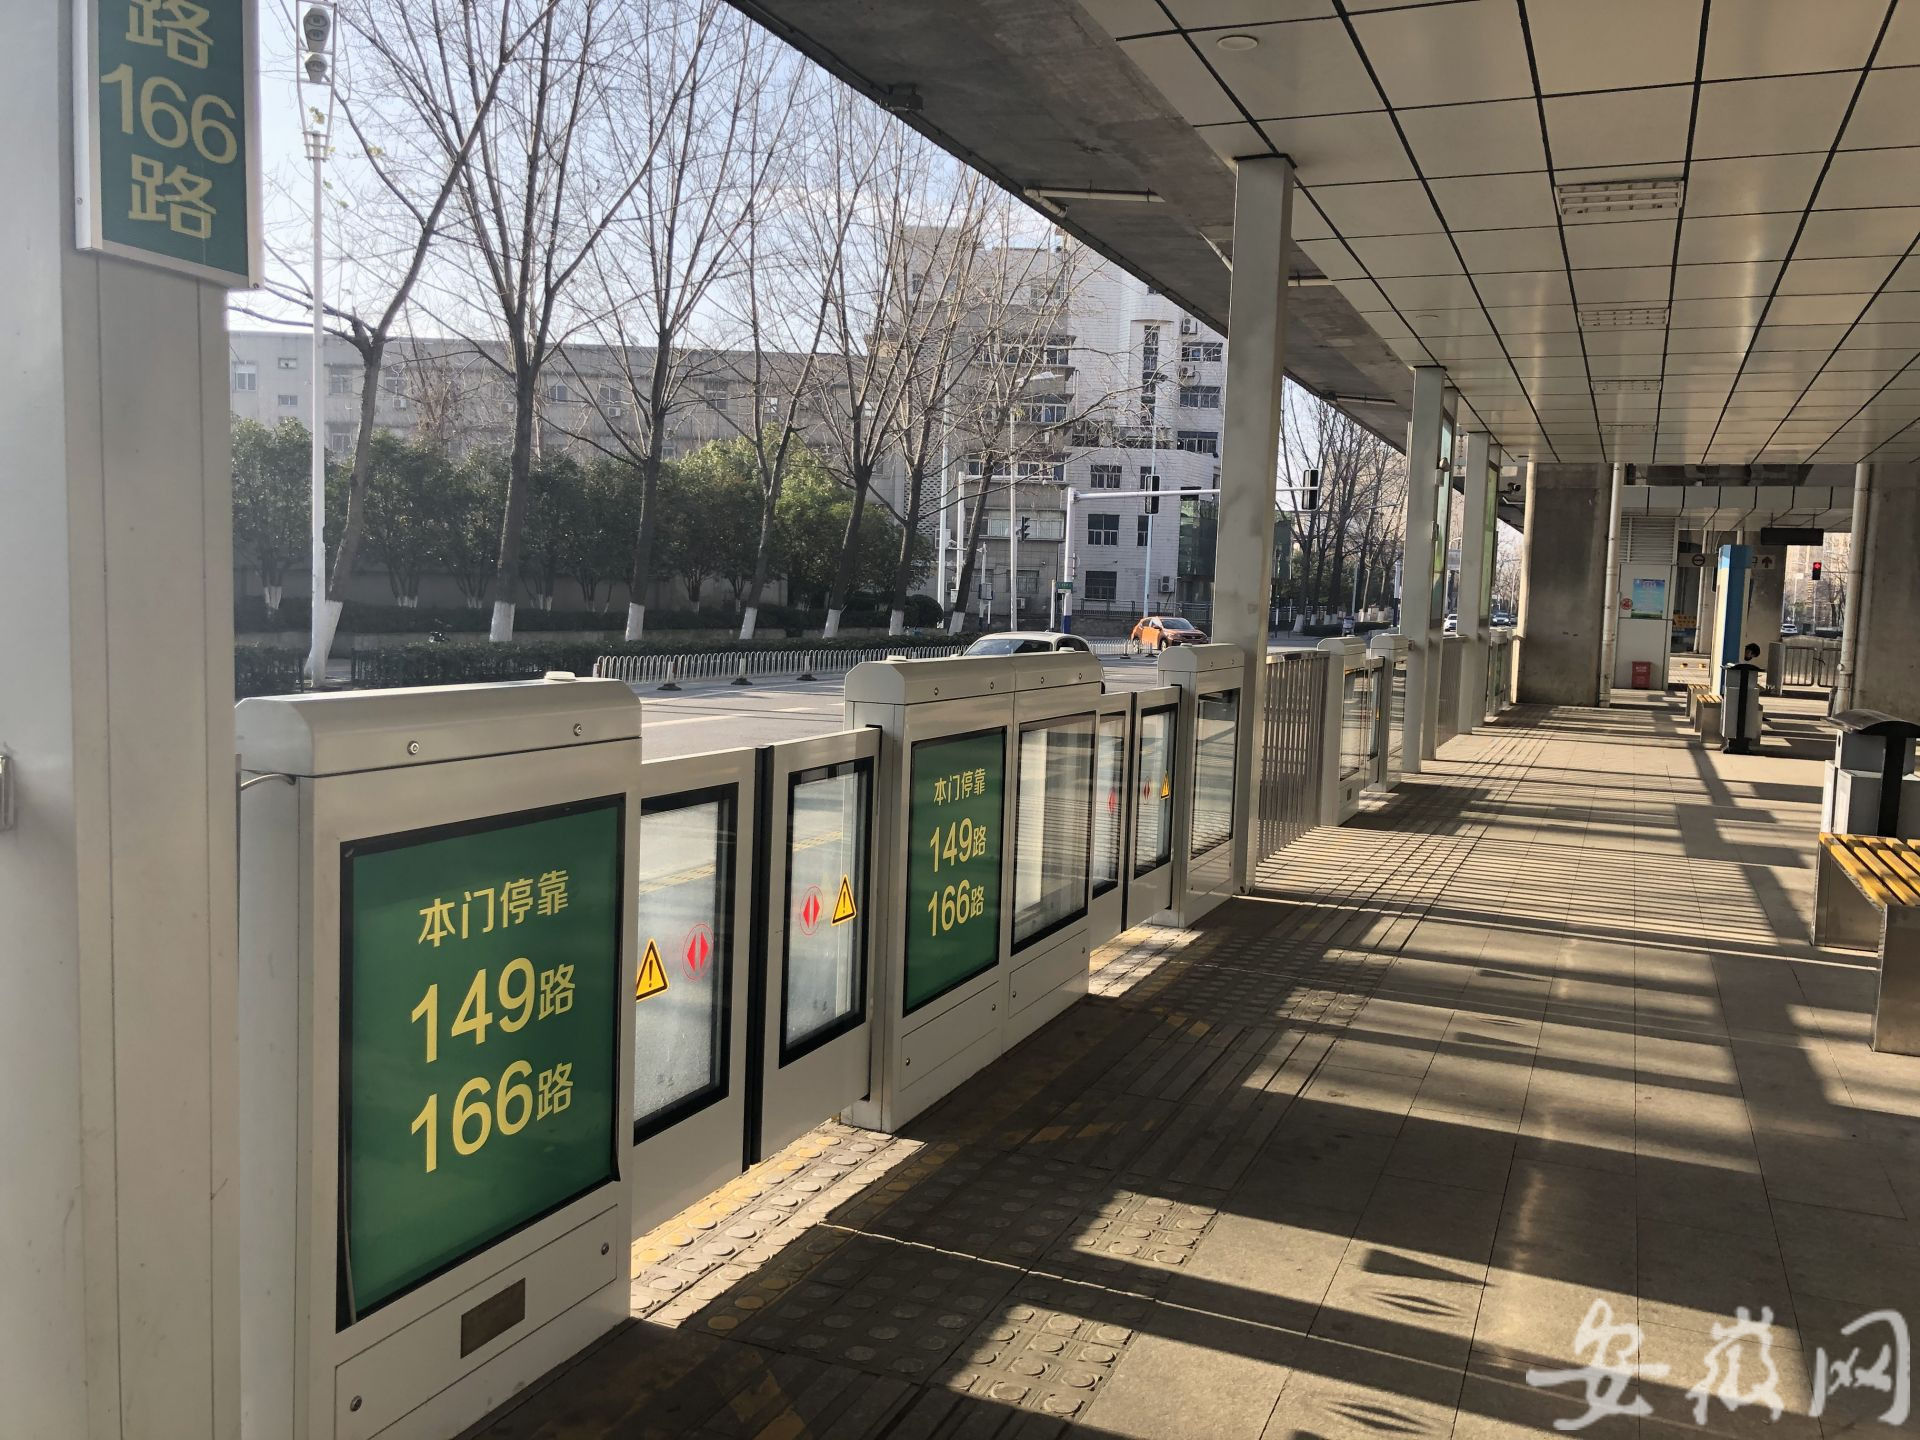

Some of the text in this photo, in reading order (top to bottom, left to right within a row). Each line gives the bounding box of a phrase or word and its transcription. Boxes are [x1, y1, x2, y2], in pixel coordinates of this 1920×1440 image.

[126, 0, 214, 69] 路
[101, 63, 237, 164] 166
[128, 153, 216, 239] 路
[934, 768, 986, 806] 本门停靠
[929, 817, 987, 873] 149路
[417, 869, 569, 947] 本门停靠
[928, 879, 985, 937] 166路
[410, 957, 575, 1062] 149路
[410, 1060, 574, 1173] 166路
